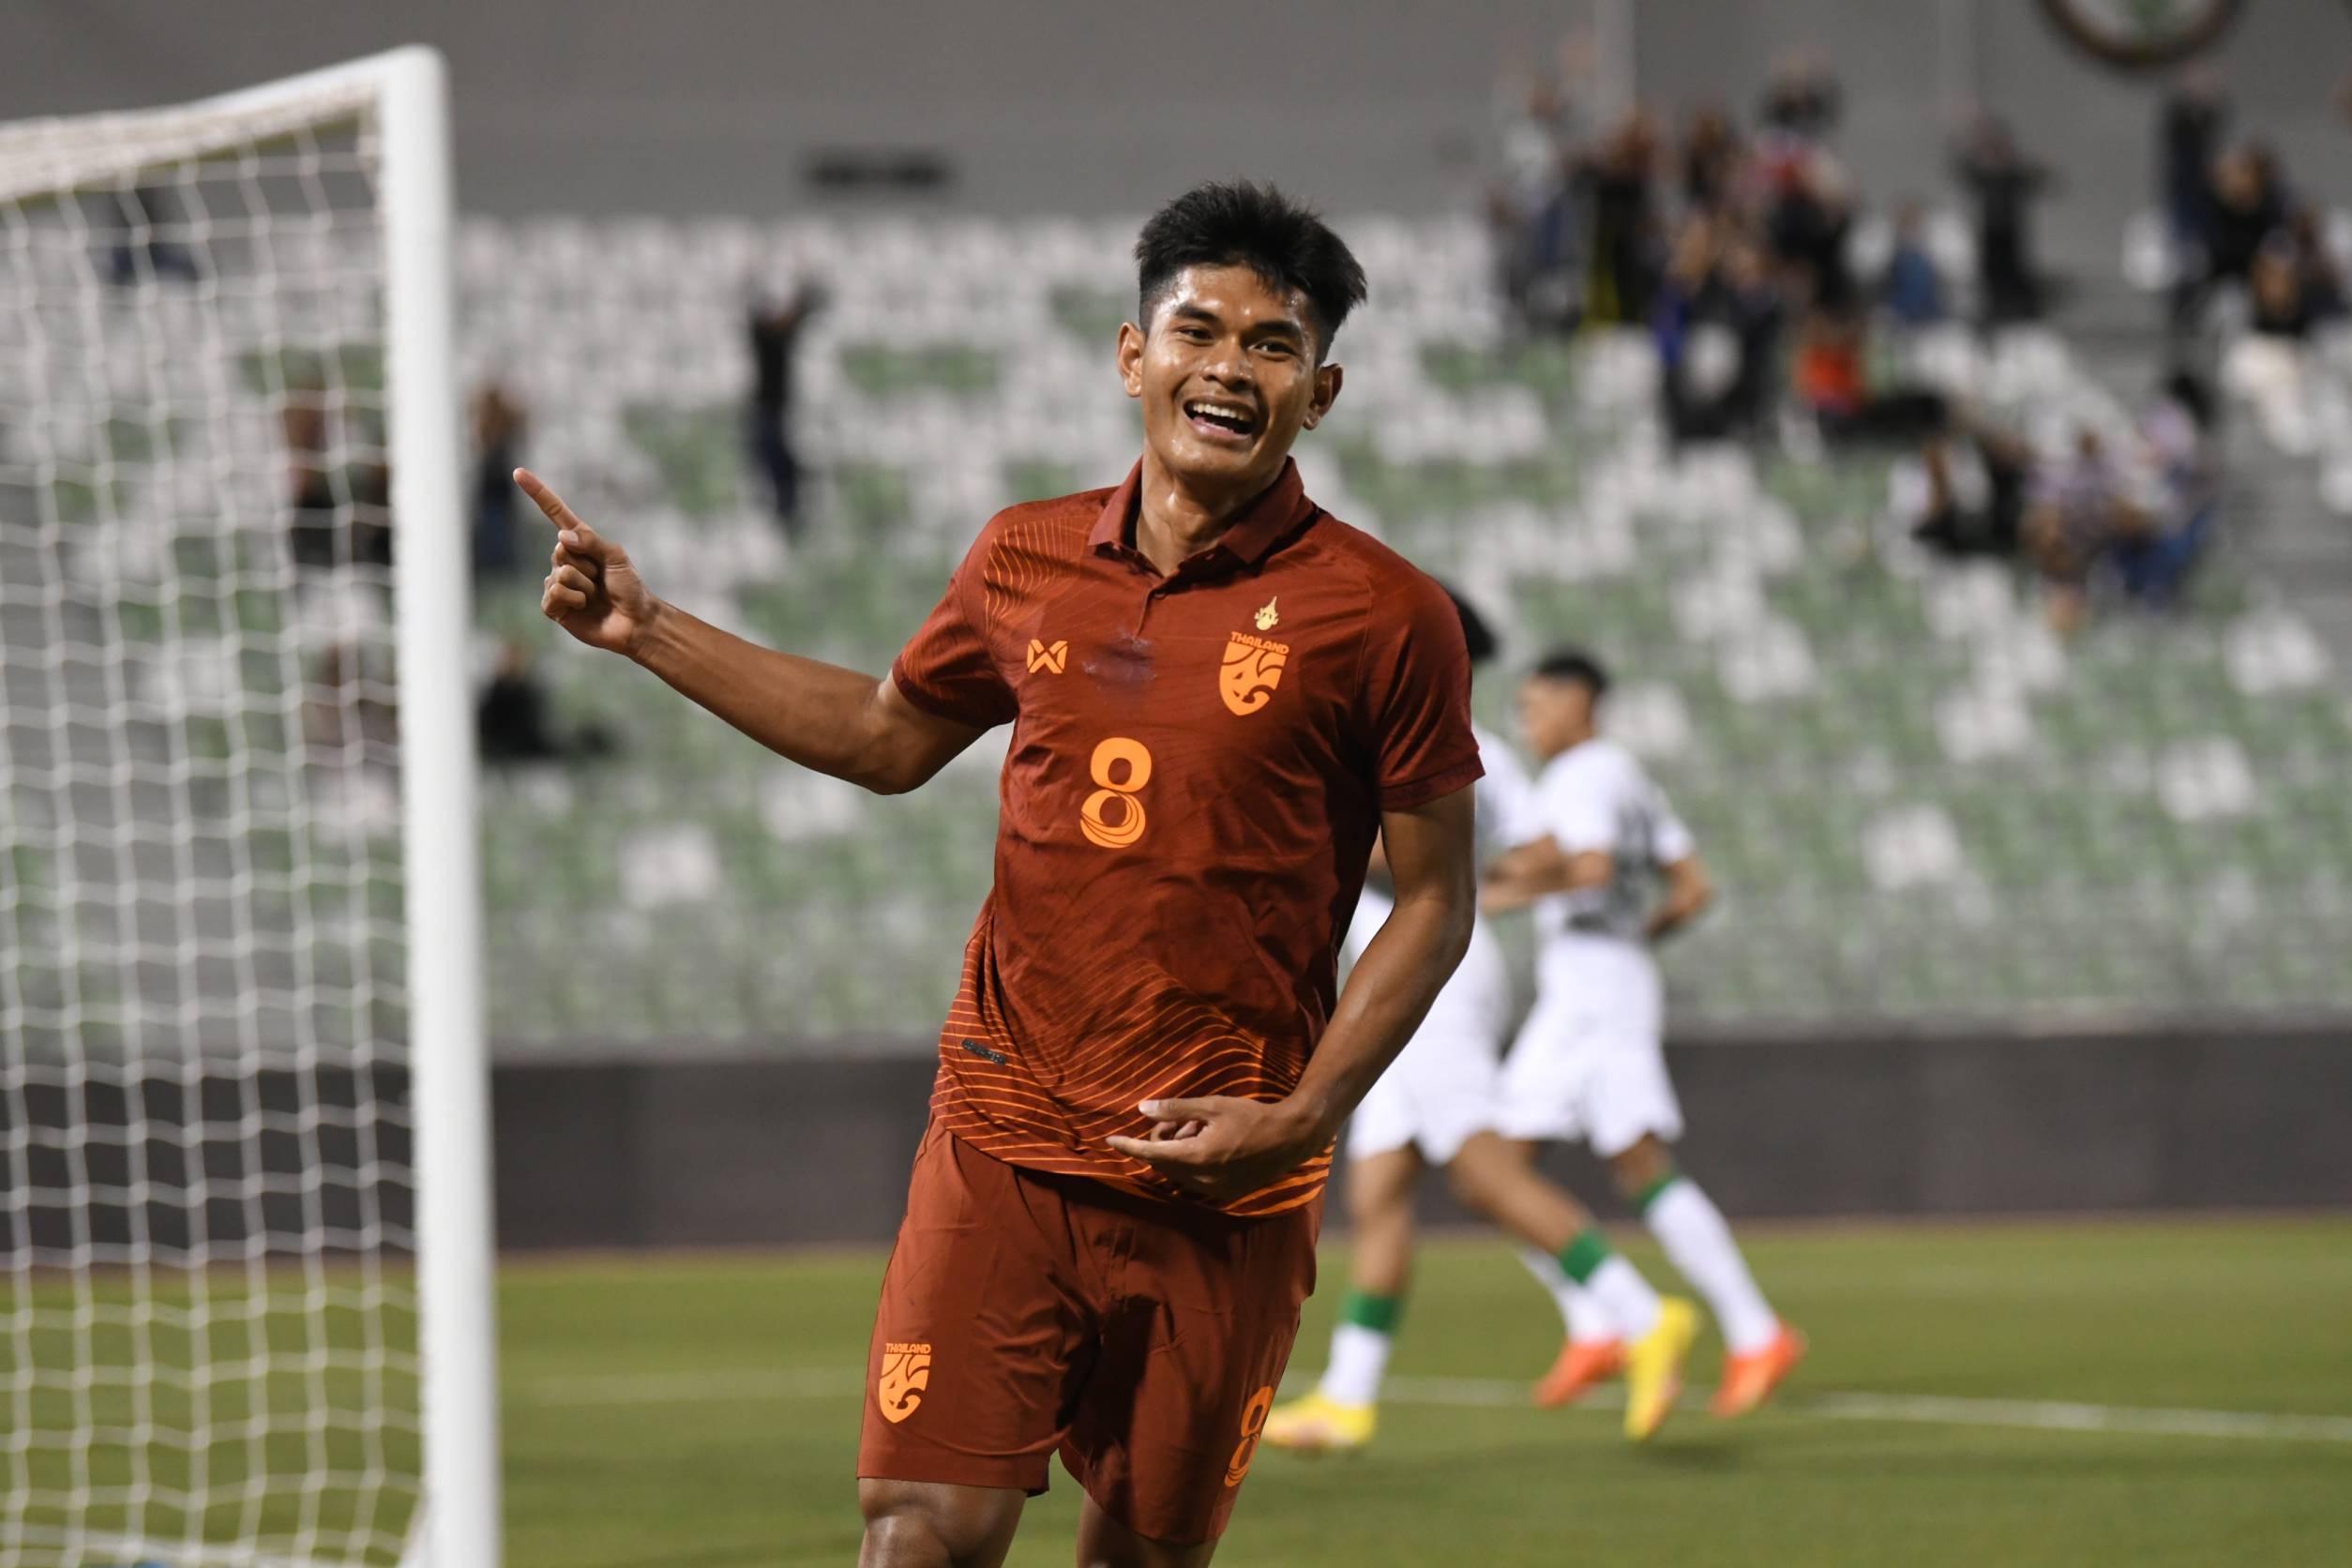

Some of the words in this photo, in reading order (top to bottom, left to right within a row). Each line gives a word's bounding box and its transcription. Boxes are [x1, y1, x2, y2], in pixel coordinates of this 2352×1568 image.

[1230, 631, 1289, 655] THAILAND
[1080, 737, 1152, 849] 8
[885, 1343, 931, 1353] THAILAND
[1224, 1386, 1274, 1487] 8
